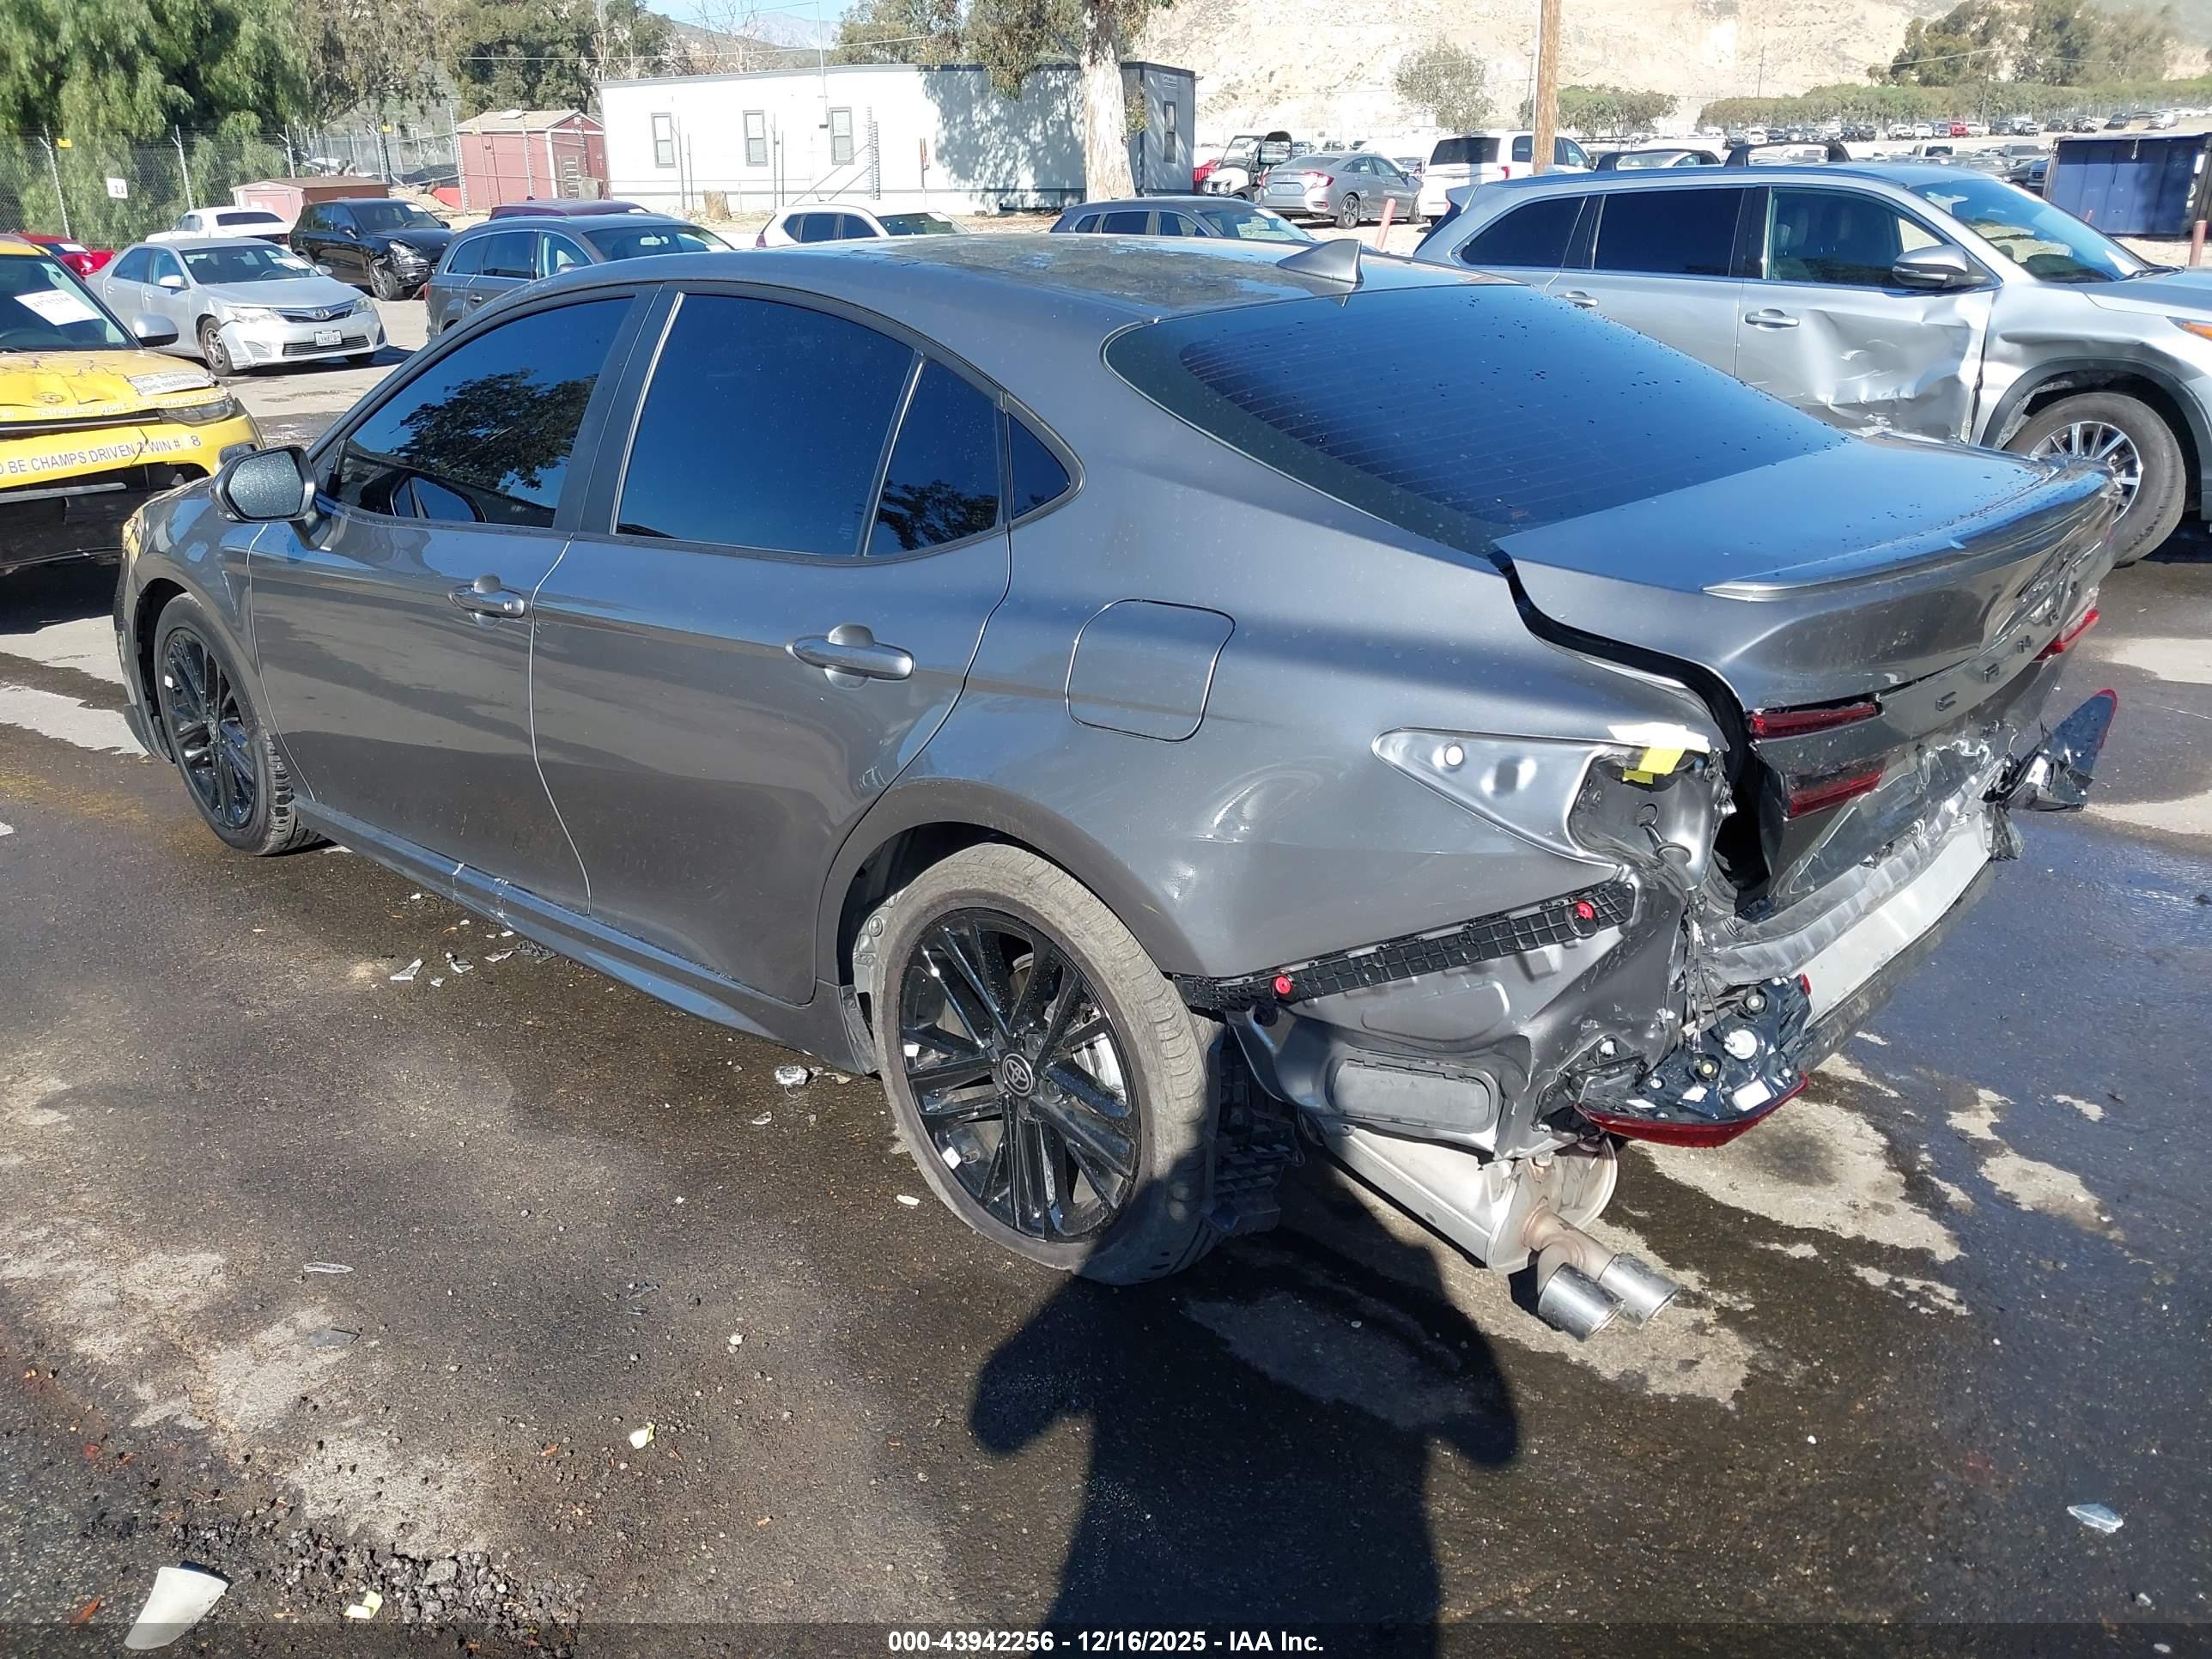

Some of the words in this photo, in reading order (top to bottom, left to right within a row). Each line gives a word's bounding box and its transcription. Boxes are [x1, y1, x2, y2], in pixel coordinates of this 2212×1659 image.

[8, 459, 27, 474] BE
[31, 451, 87, 471] CHAMPS
[88, 443, 137, 463] DRIVEN
[149, 440, 172, 453] WIN
[173, 439, 180, 449] #
[191, 435, 201, 447] 8
